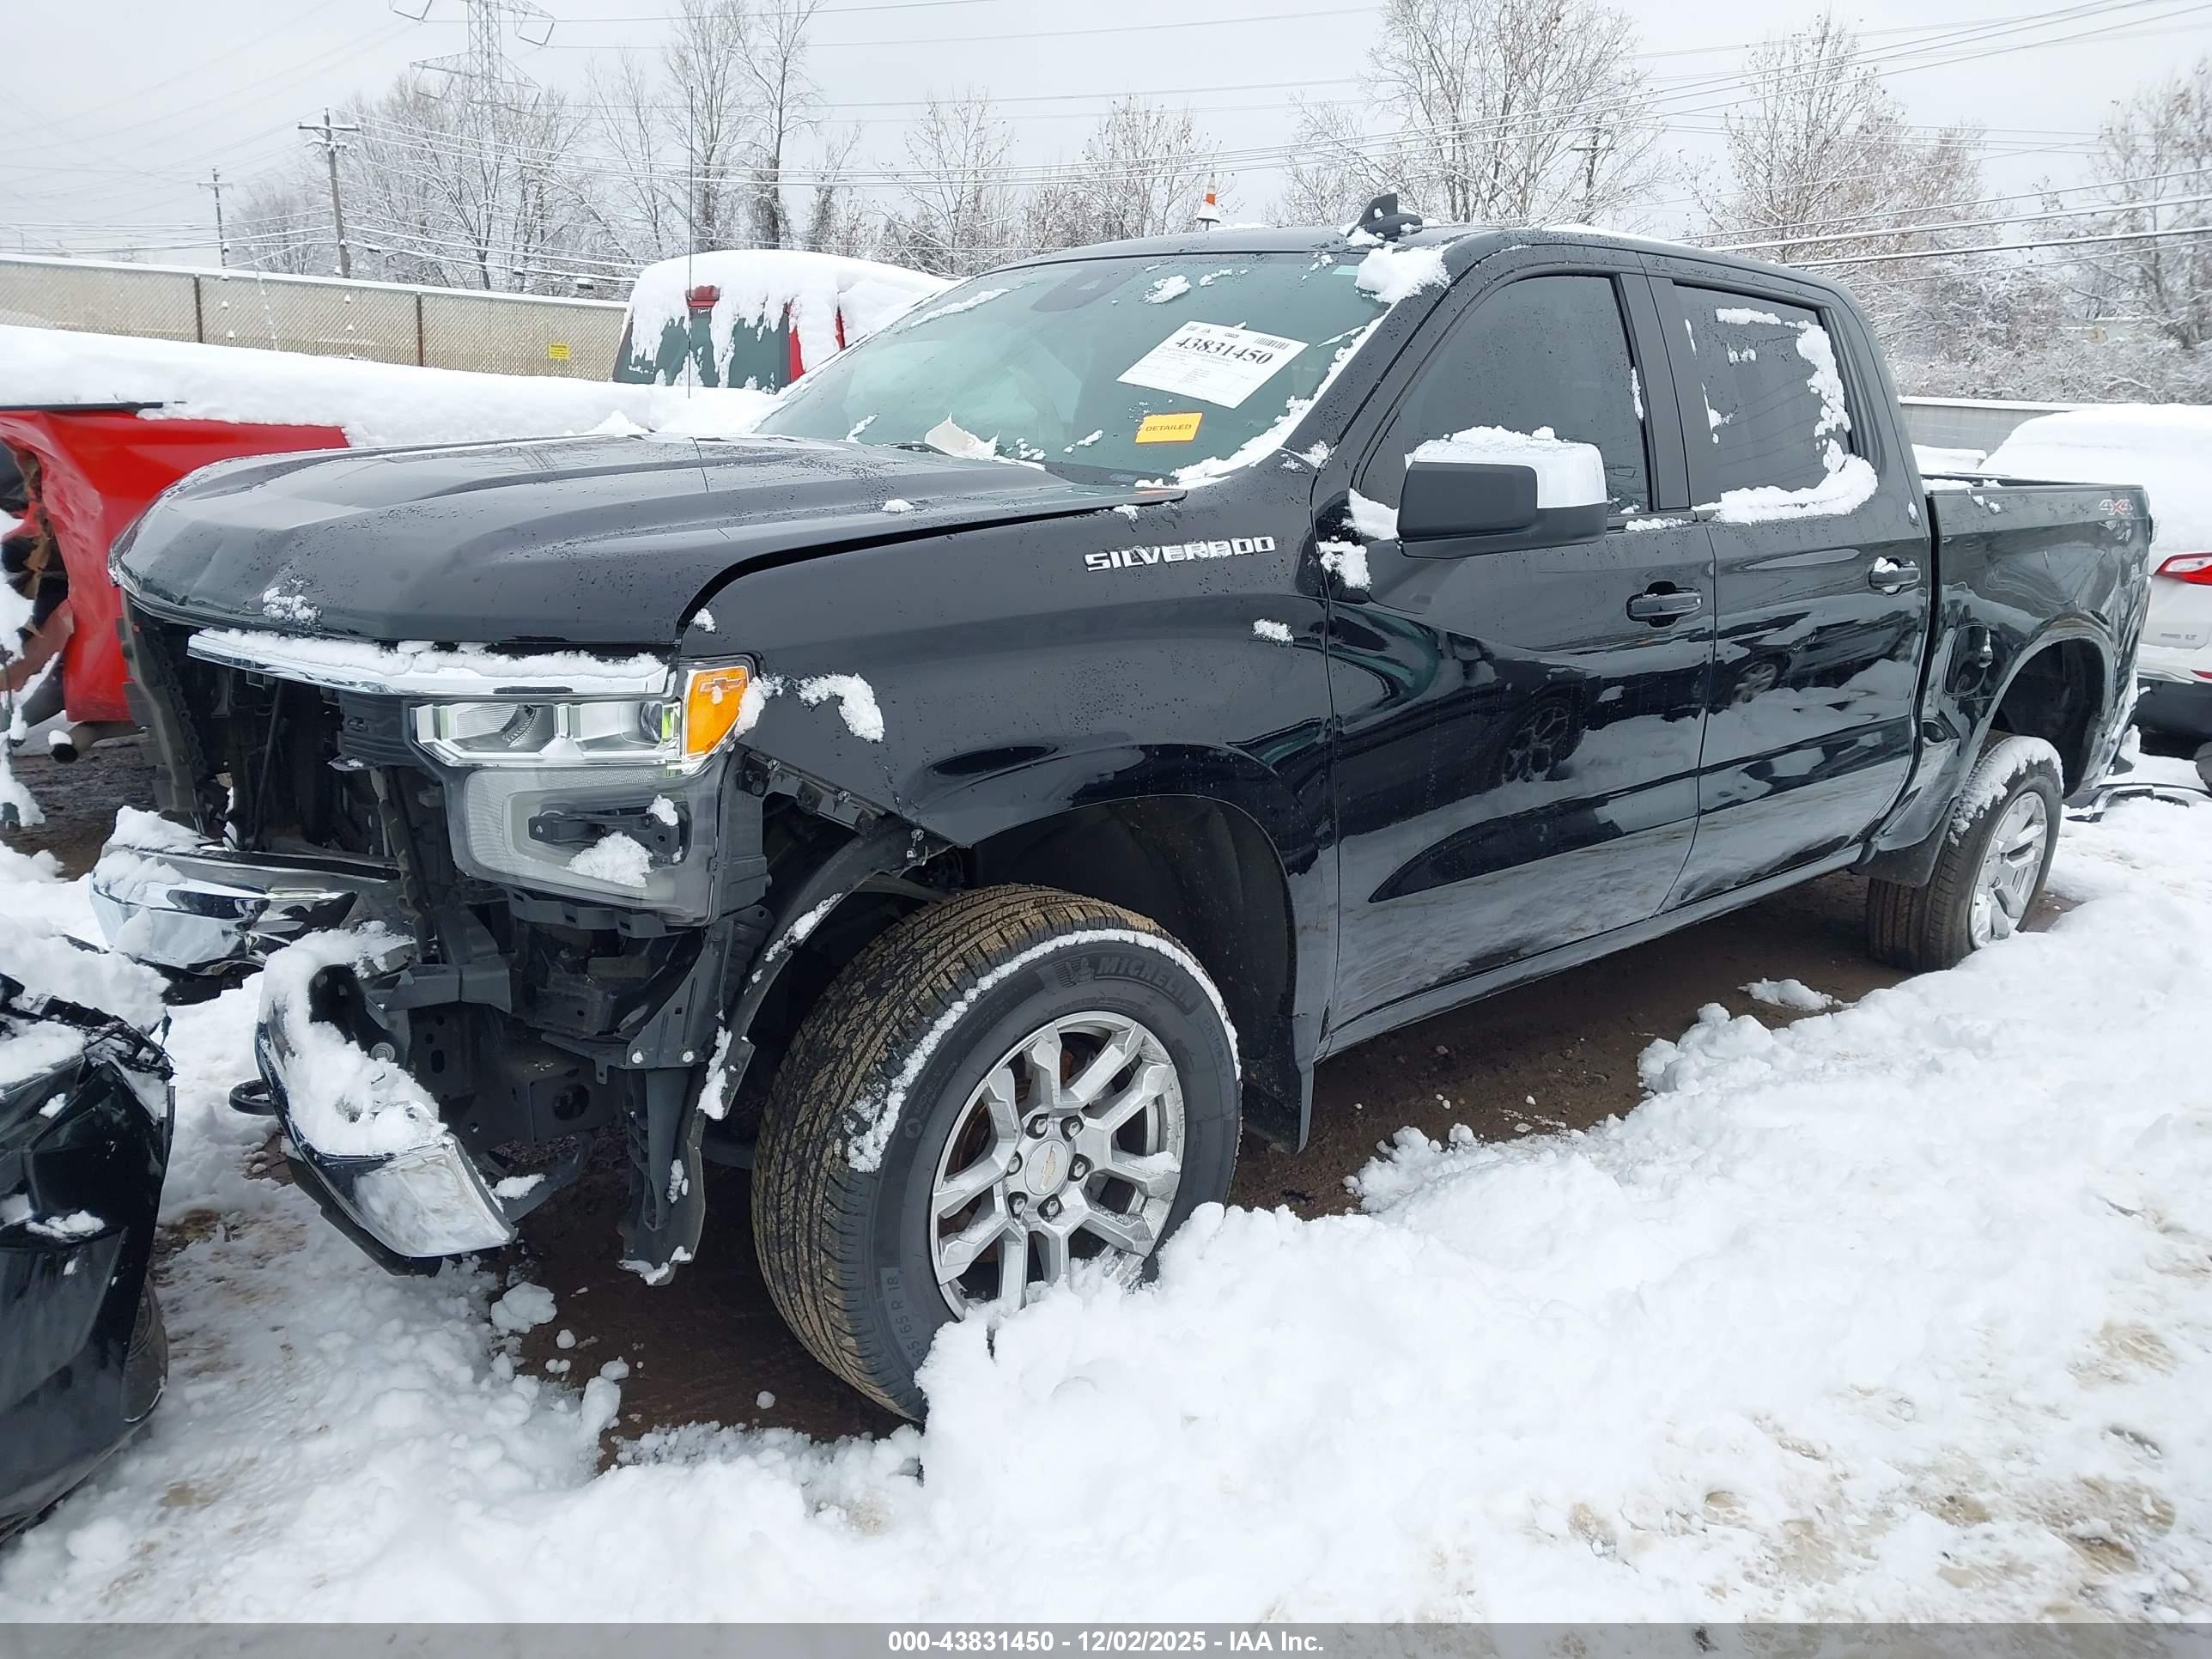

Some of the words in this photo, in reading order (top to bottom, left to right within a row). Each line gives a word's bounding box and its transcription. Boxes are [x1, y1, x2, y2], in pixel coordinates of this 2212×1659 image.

[1176, 337, 1274, 365] 43831450
[1146, 423, 1192, 432] DETAILED
[1084, 536, 1276, 572] SILVERADO
[1097, 955, 1196, 1011] MICHELIN
